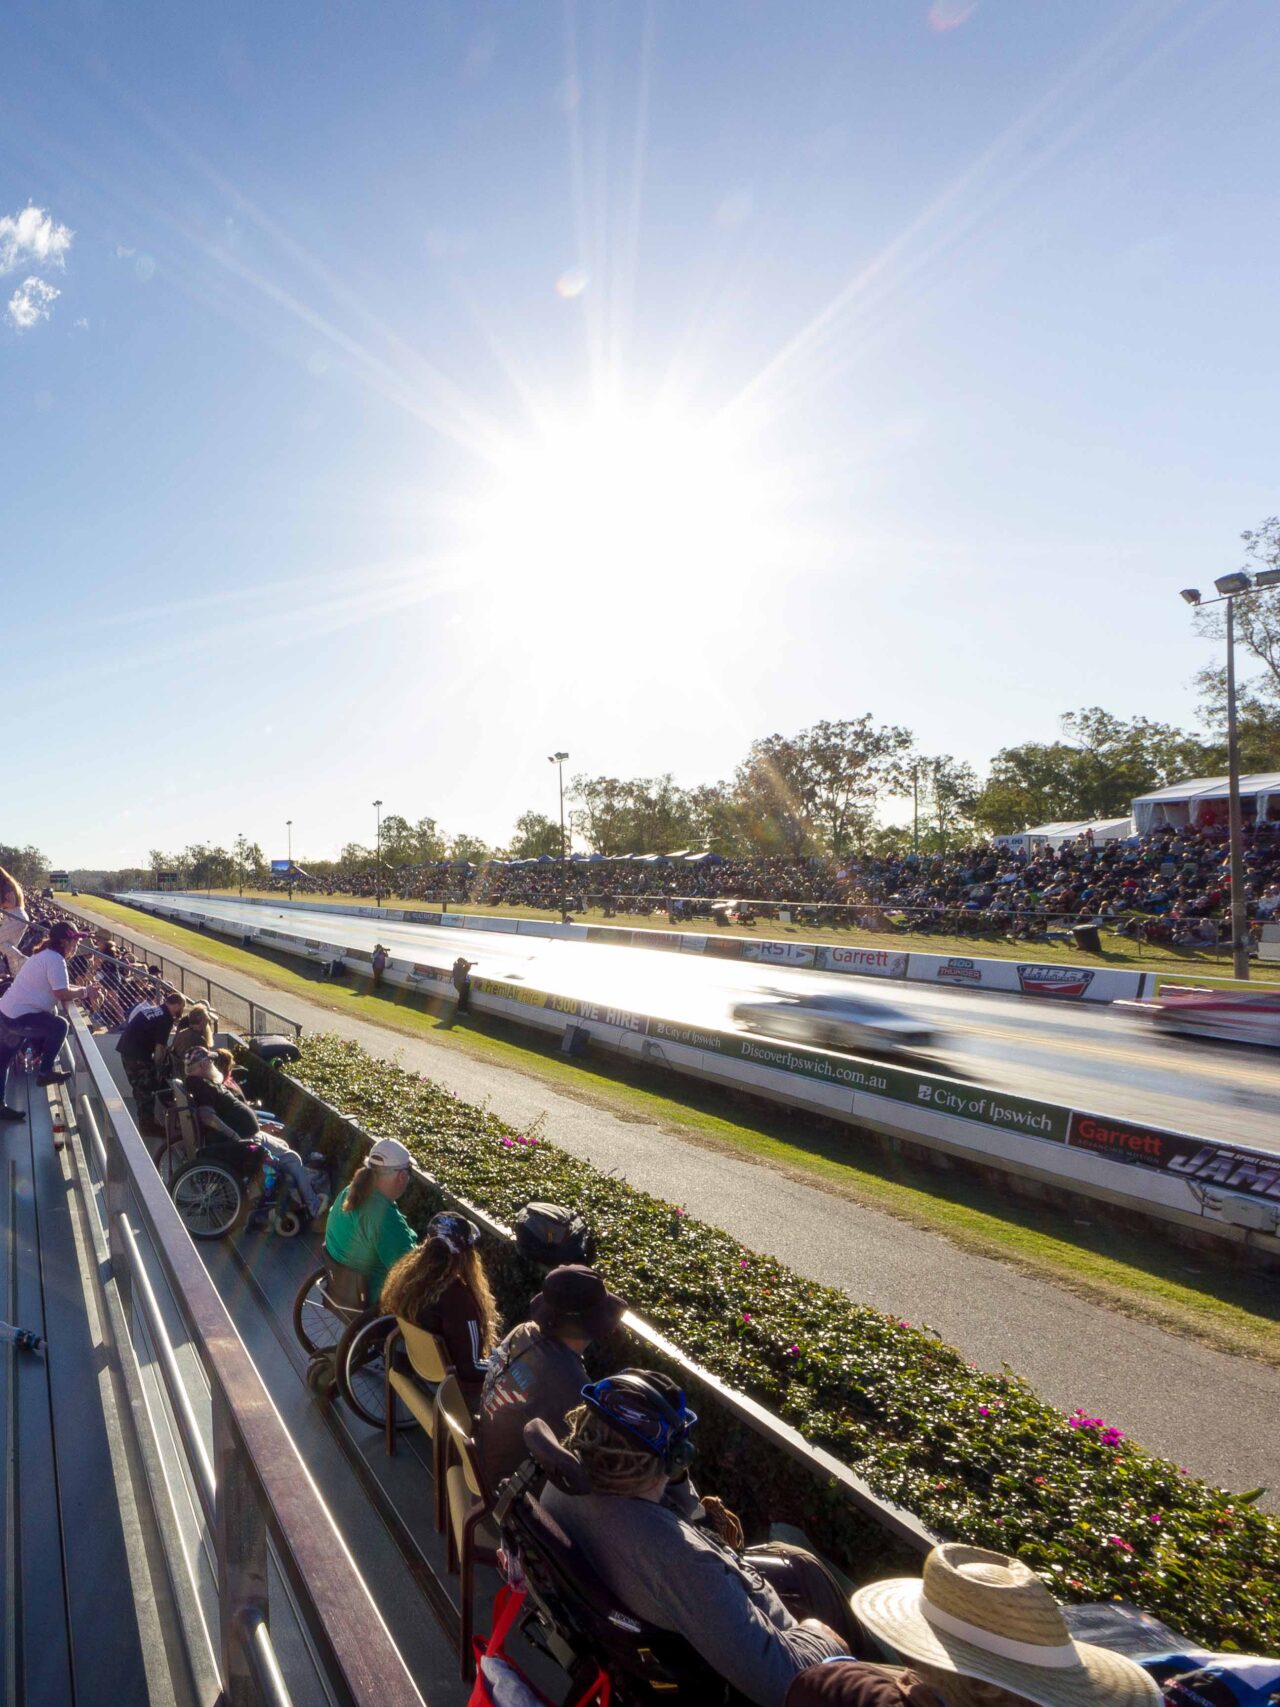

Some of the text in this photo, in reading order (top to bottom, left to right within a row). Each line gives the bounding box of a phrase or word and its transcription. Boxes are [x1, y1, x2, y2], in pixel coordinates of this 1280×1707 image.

[761, 941, 797, 957] RST
[832, 947, 888, 967] Garrett
[939, 967, 980, 979] THUNDER
[552, 994, 640, 1031] 1300 WE HIRE
[665, 1026, 721, 1048] City of Ipswich
[741, 1041, 888, 1090] DiscoverIpswich.com.au
[934, 1088, 1053, 1132] City of Ipswich
[1078, 1119, 1163, 1156] Garrett
